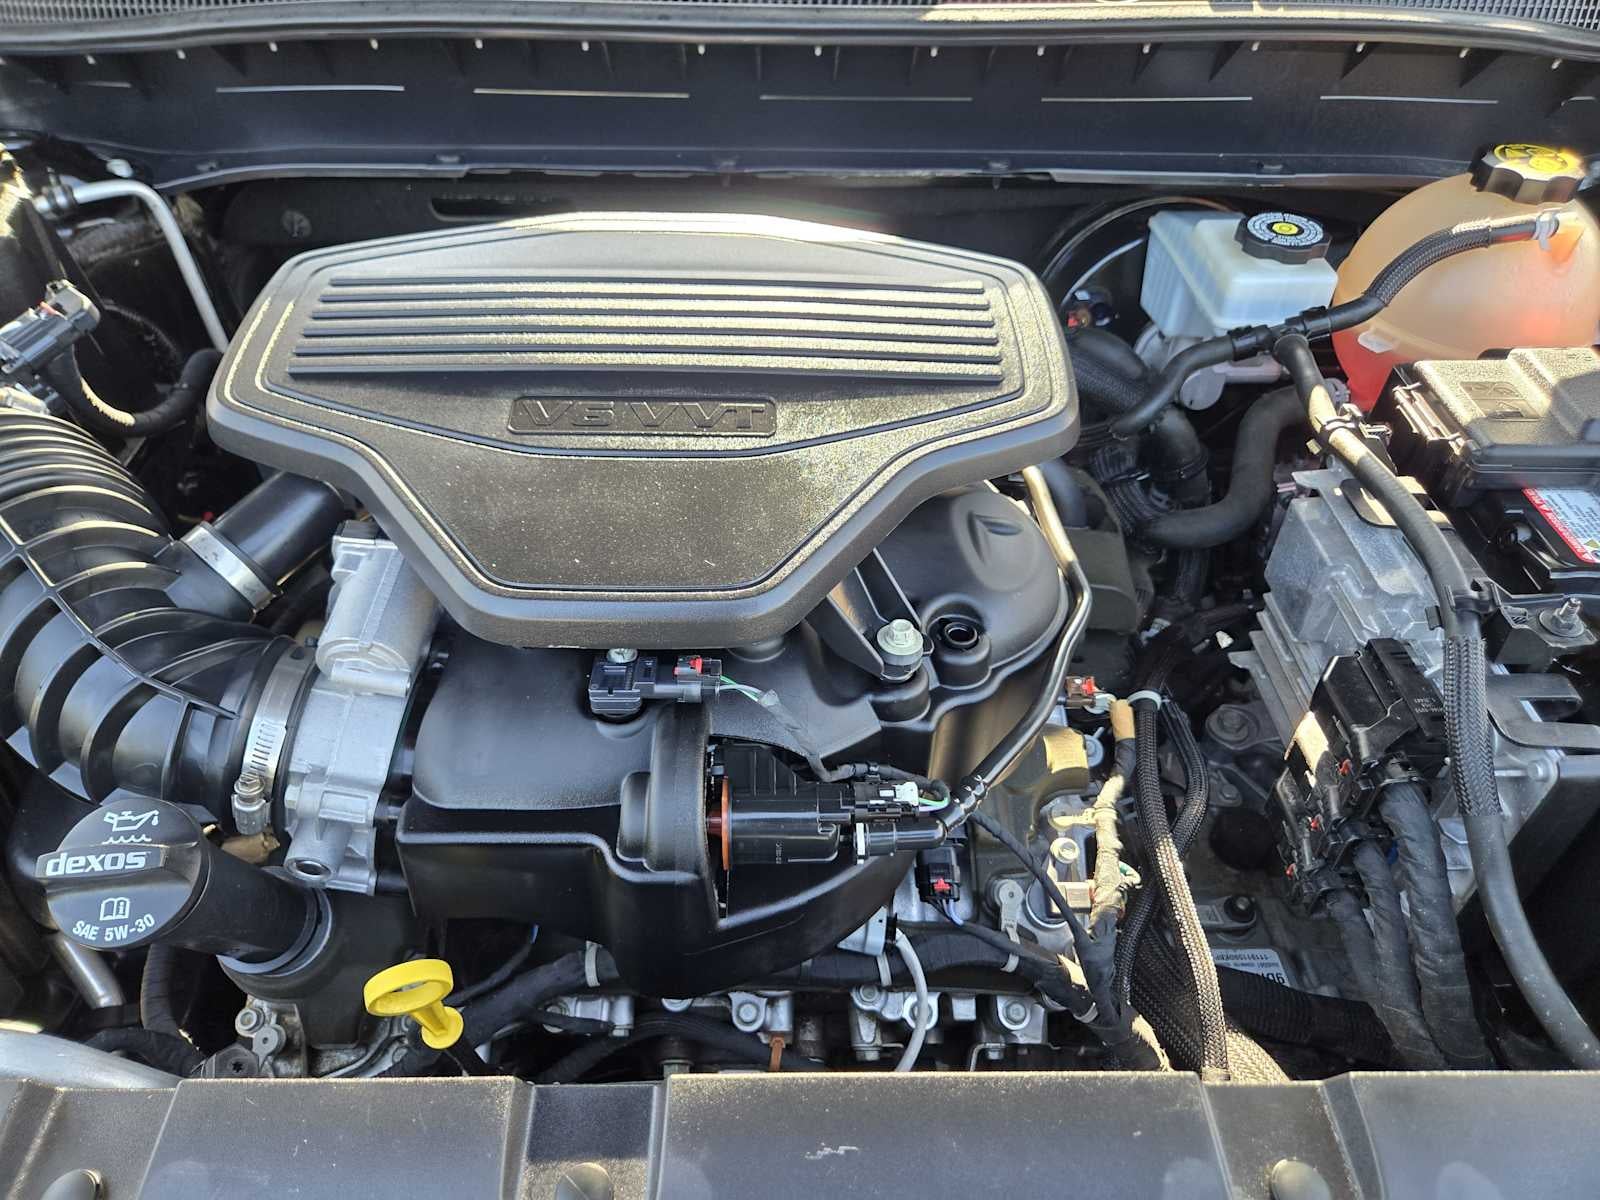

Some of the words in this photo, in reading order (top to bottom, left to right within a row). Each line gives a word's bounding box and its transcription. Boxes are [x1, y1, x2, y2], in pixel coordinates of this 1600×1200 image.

[521, 400, 615, 427] V6
[629, 401, 767, 429] VVT
[45, 851, 147, 876] dexos
[72, 920, 99, 942] SAE
[104, 913, 156, 942] 5W-30
